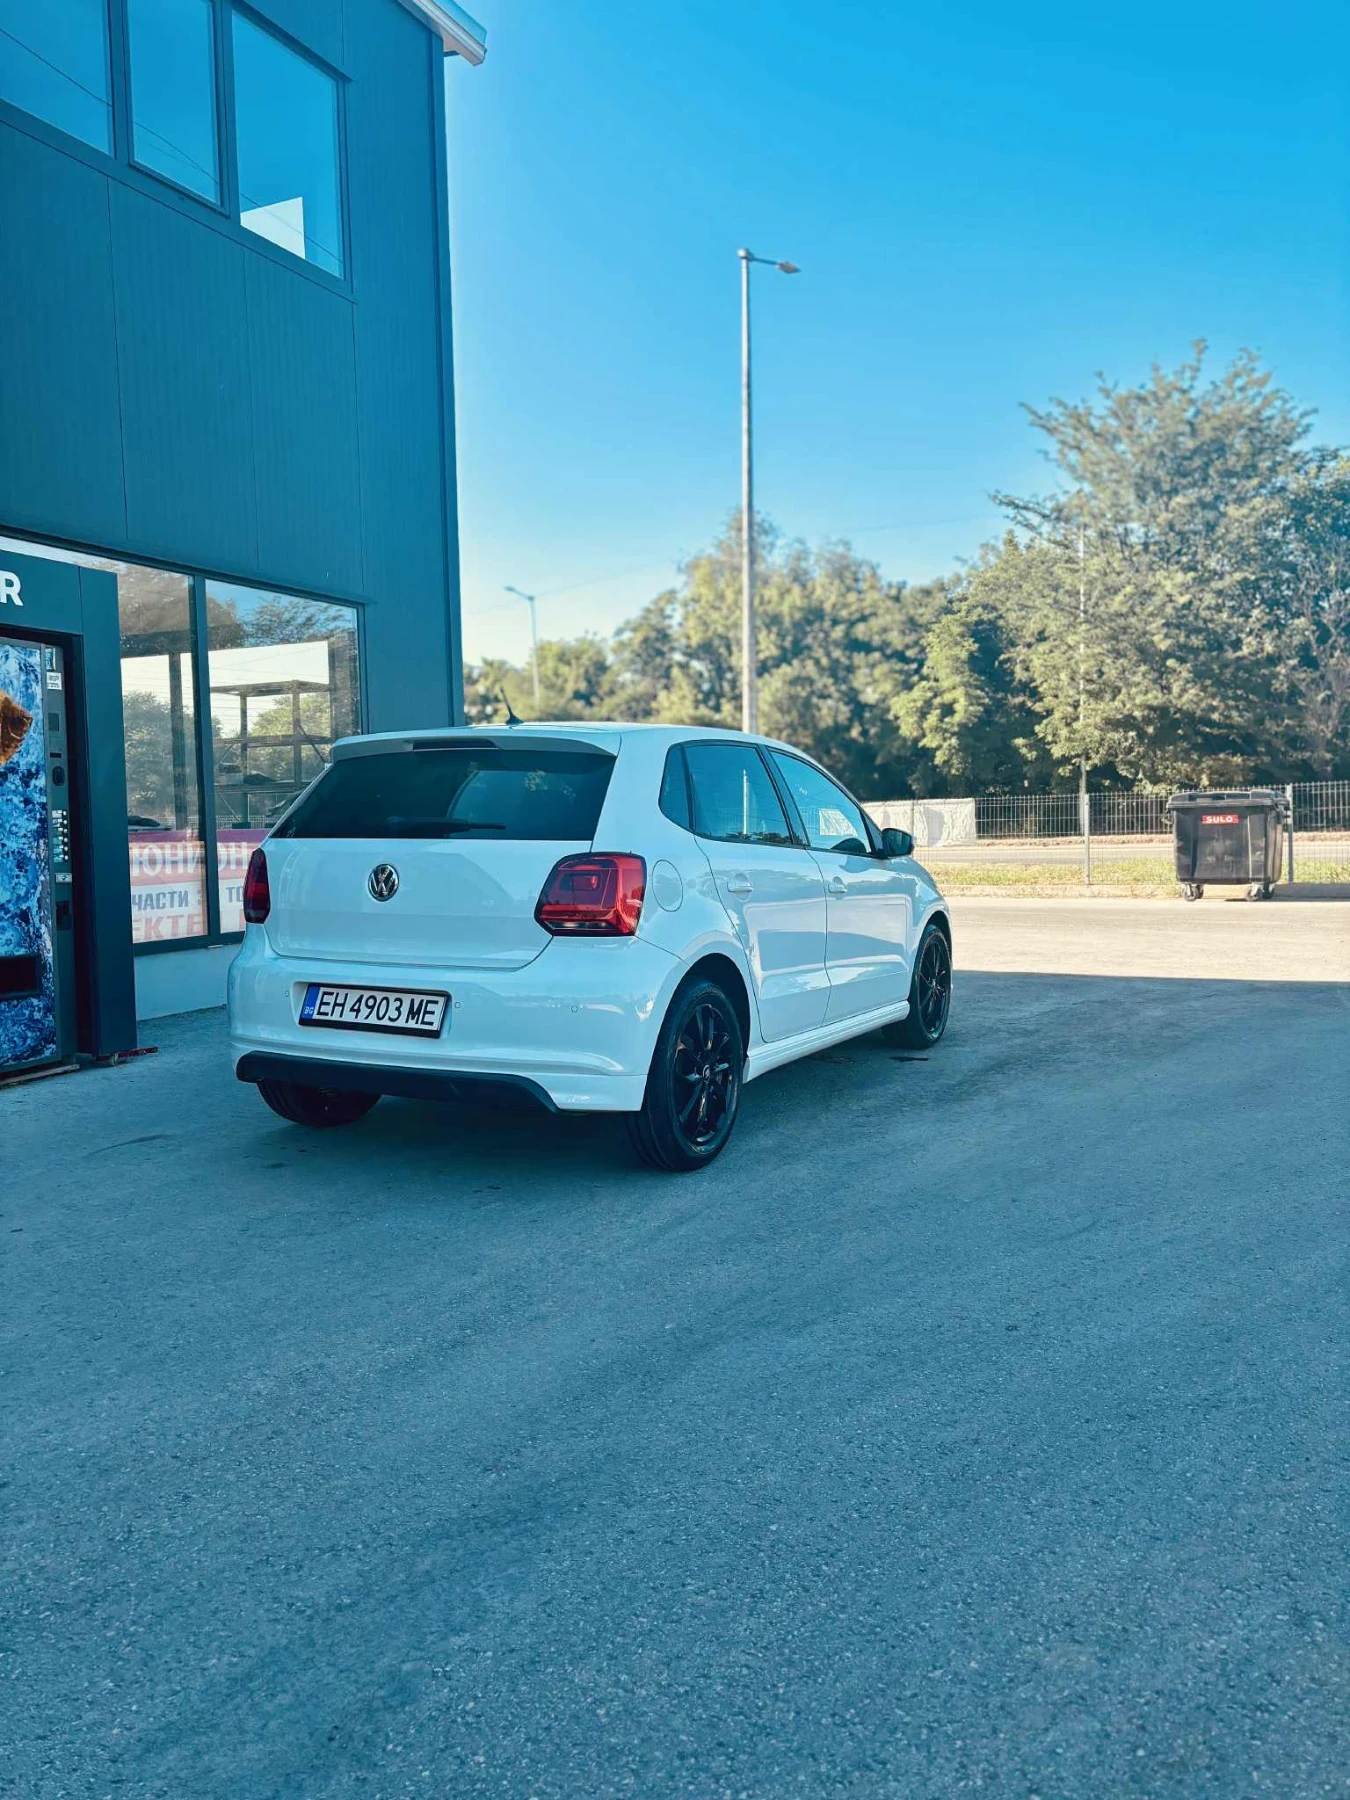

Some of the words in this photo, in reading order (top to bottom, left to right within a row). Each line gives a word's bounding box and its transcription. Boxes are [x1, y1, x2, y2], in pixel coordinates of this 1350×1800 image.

[1206, 815, 1233, 824] SULO
[304, 1006, 314, 1015] BG
[316, 991, 348, 1018] EH
[350, 994, 403, 1023] 4903
[405, 998, 439, 1026] ME
